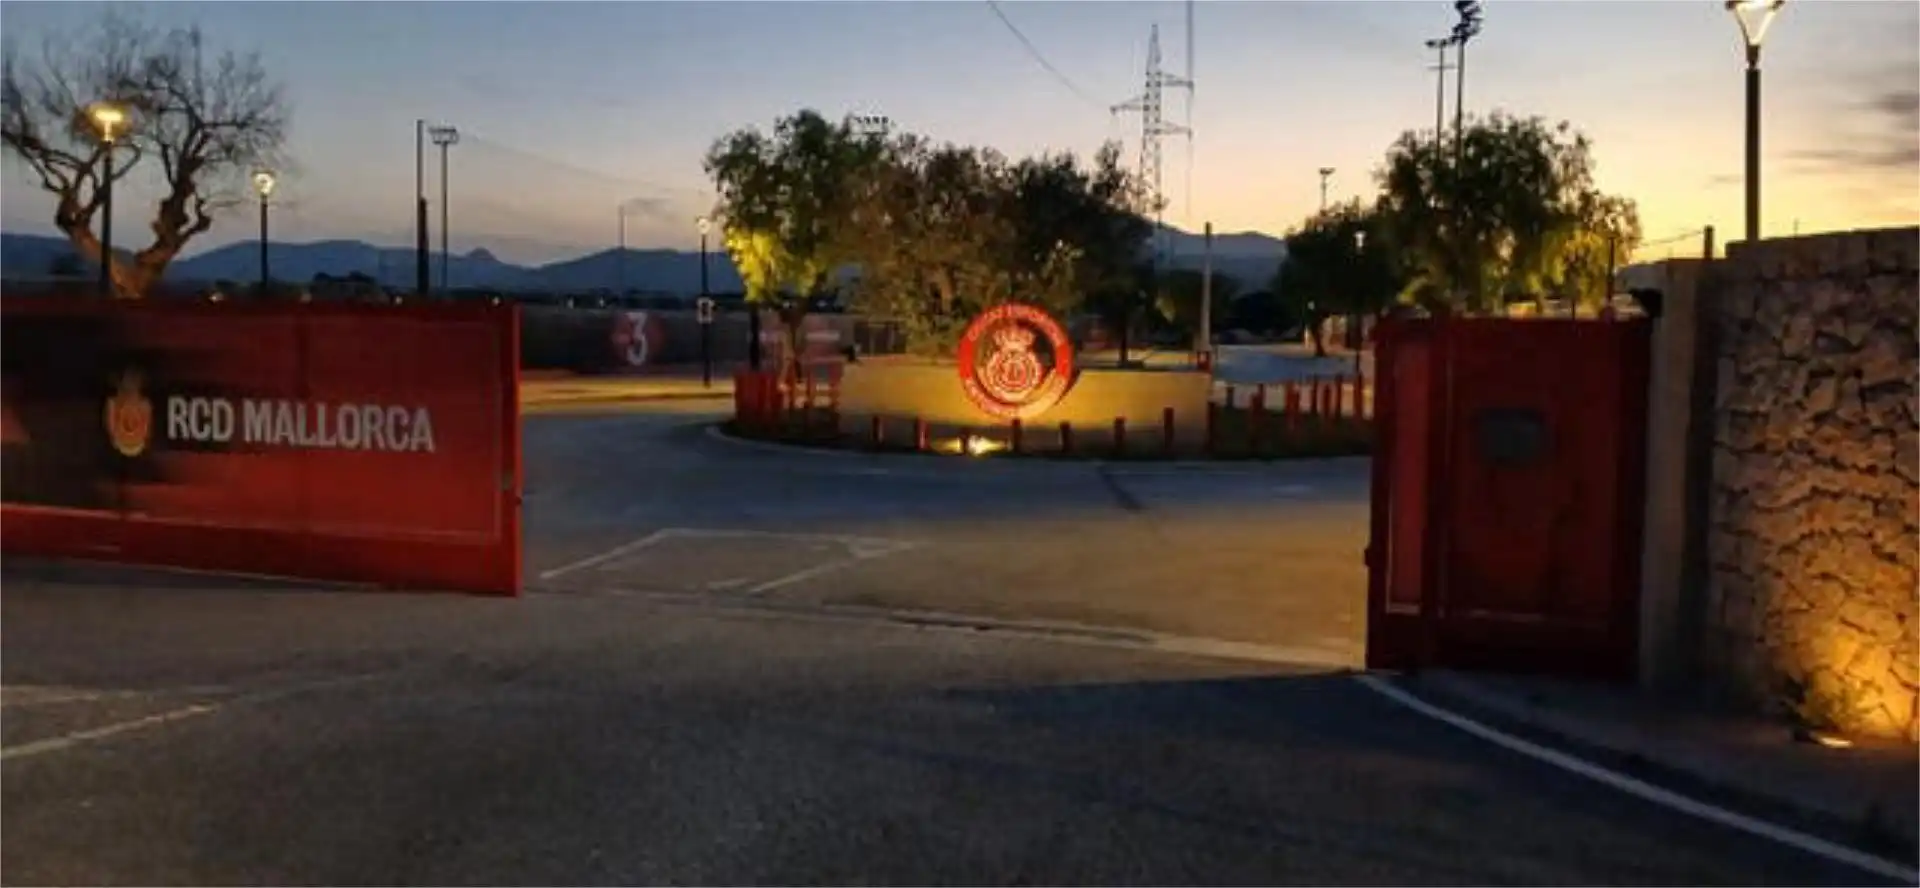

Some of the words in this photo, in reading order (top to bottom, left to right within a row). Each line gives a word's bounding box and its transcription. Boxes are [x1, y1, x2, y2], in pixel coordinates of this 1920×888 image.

[625, 311, 648, 366] 3
[167, 395, 235, 442] RCD
[243, 398, 436, 453] MALLORCA
